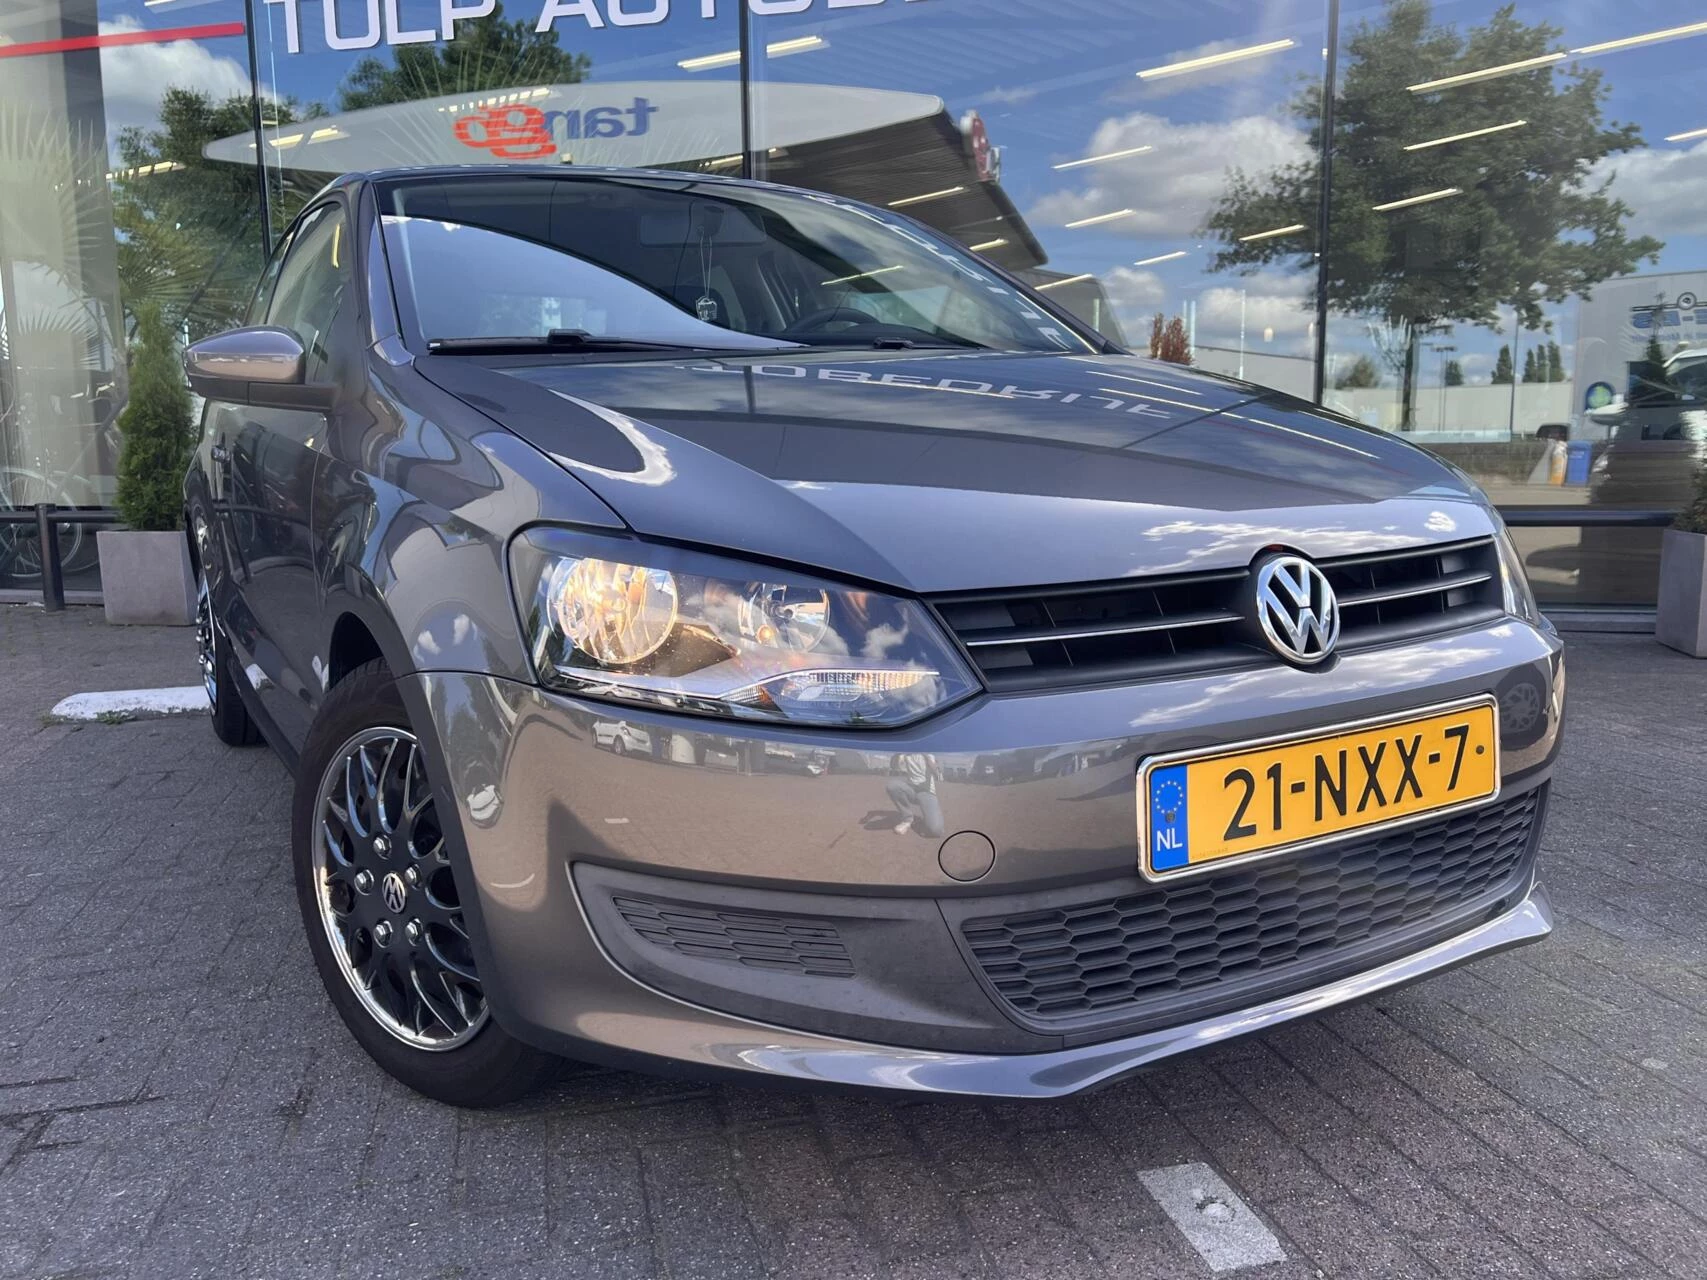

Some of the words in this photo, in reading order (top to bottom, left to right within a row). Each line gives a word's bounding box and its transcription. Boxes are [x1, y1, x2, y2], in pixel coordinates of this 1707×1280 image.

[263, 0, 496, 53] TULP
[1223, 725, 1469, 841] 21-NXX-7
[1156, 827, 1184, 852] NL
